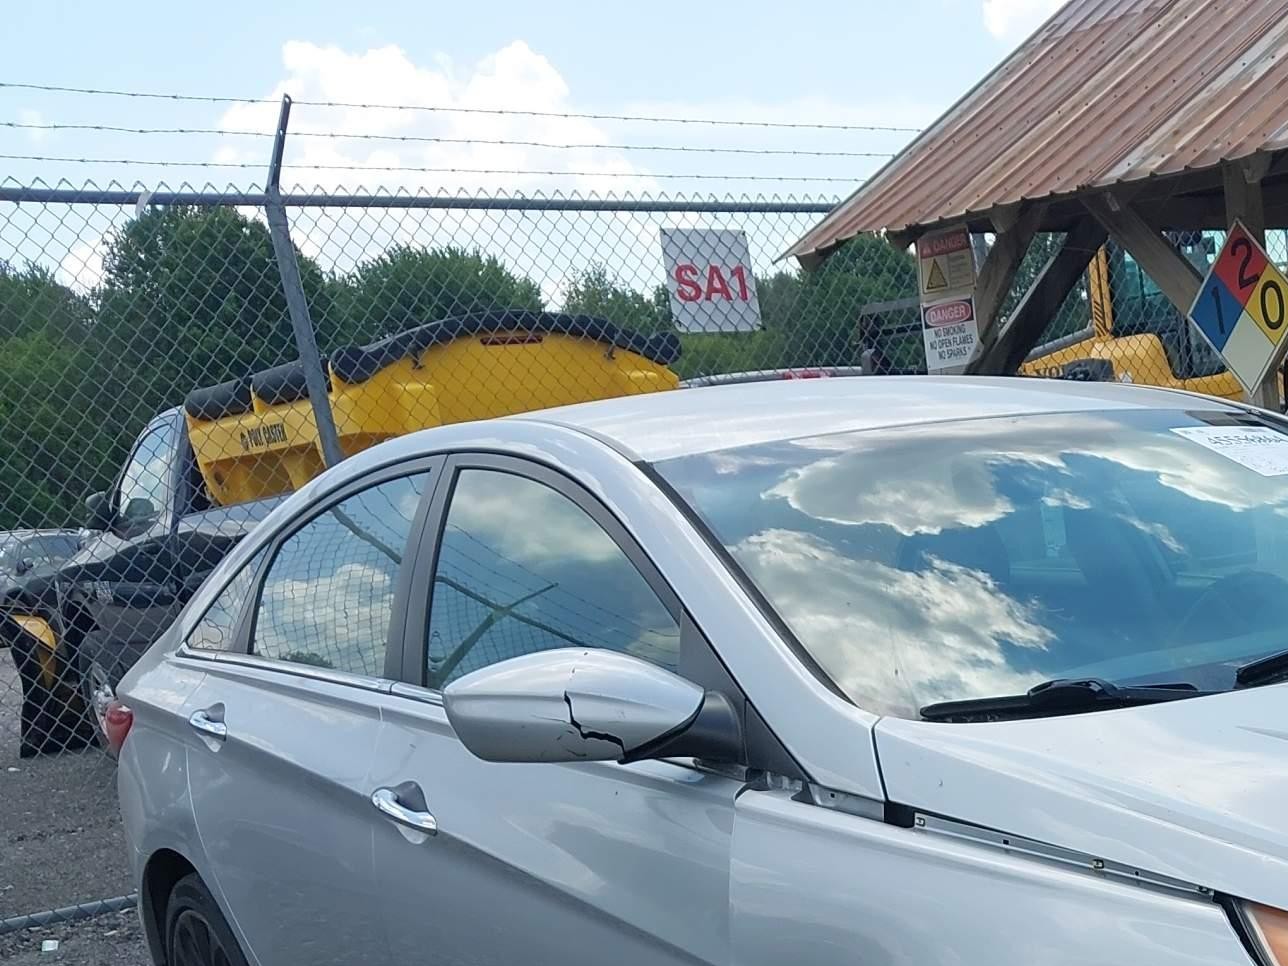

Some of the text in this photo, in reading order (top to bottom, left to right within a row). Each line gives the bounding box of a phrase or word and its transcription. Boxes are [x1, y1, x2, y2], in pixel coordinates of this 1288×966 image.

[675, 264, 748, 302] SA1
[1230, 237, 1259, 290] 2
[930, 305, 966, 322] DANGER
[1211, 286, 1225, 334] 1
[1260, 280, 1285, 330] 0
